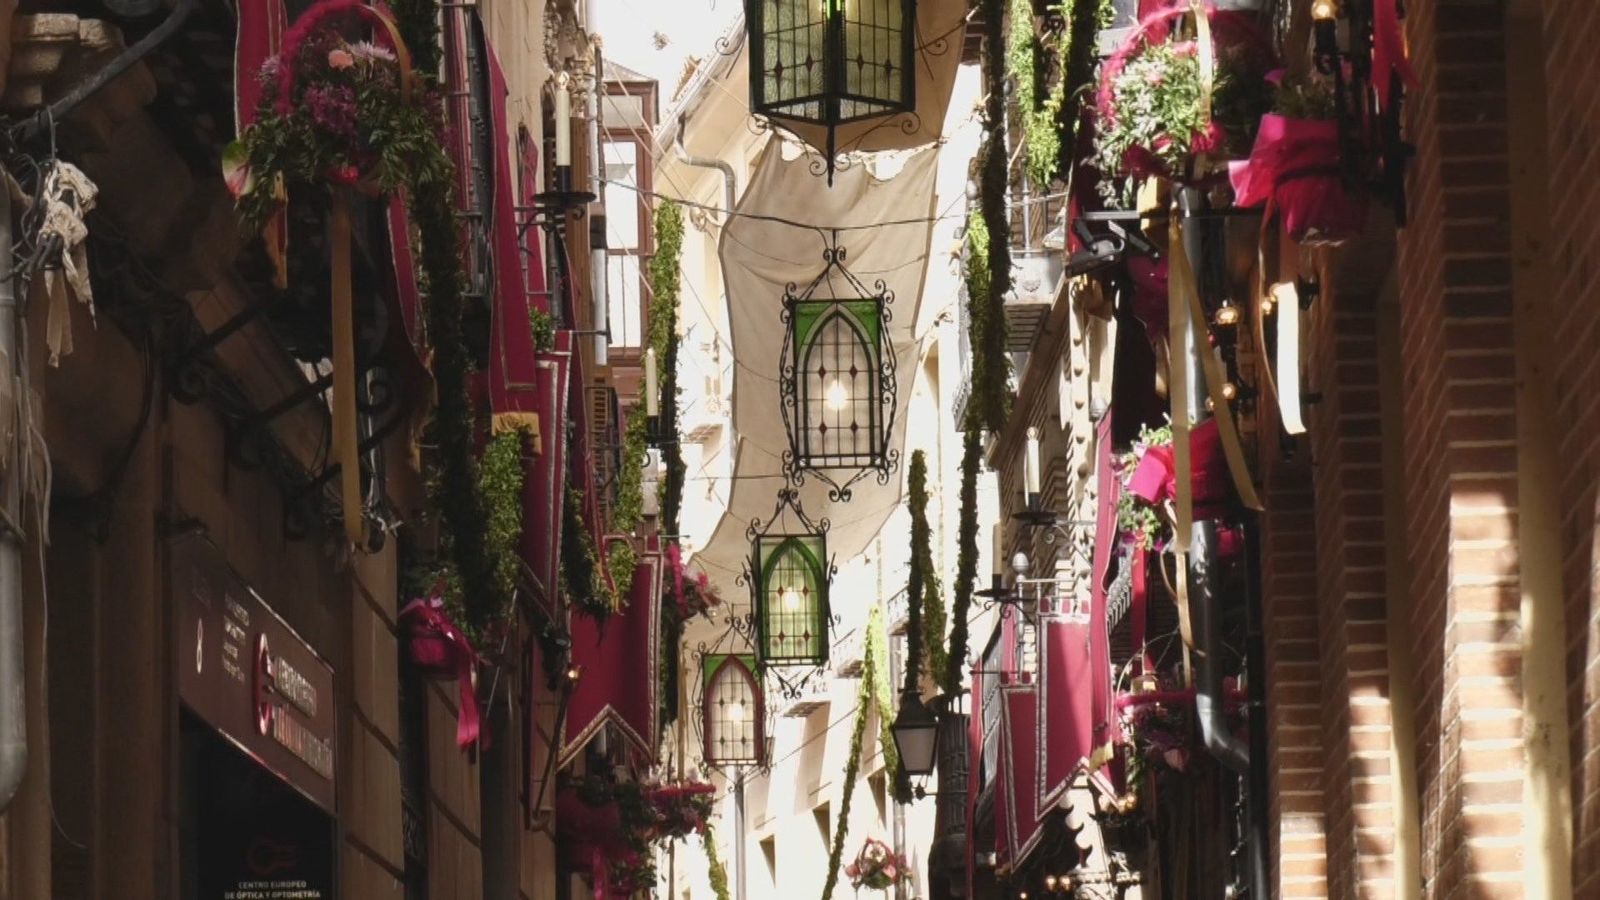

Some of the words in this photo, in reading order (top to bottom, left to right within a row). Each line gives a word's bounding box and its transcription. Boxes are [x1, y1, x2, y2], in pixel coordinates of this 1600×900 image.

[238, 881, 269, 889] CENTRO
[271, 880, 307, 888] EUROPEO
[224, 891, 235, 899] DE
[236, 890, 264, 899] ÓPTICA
[271, 889, 321, 899] OPTOMETRÍA
